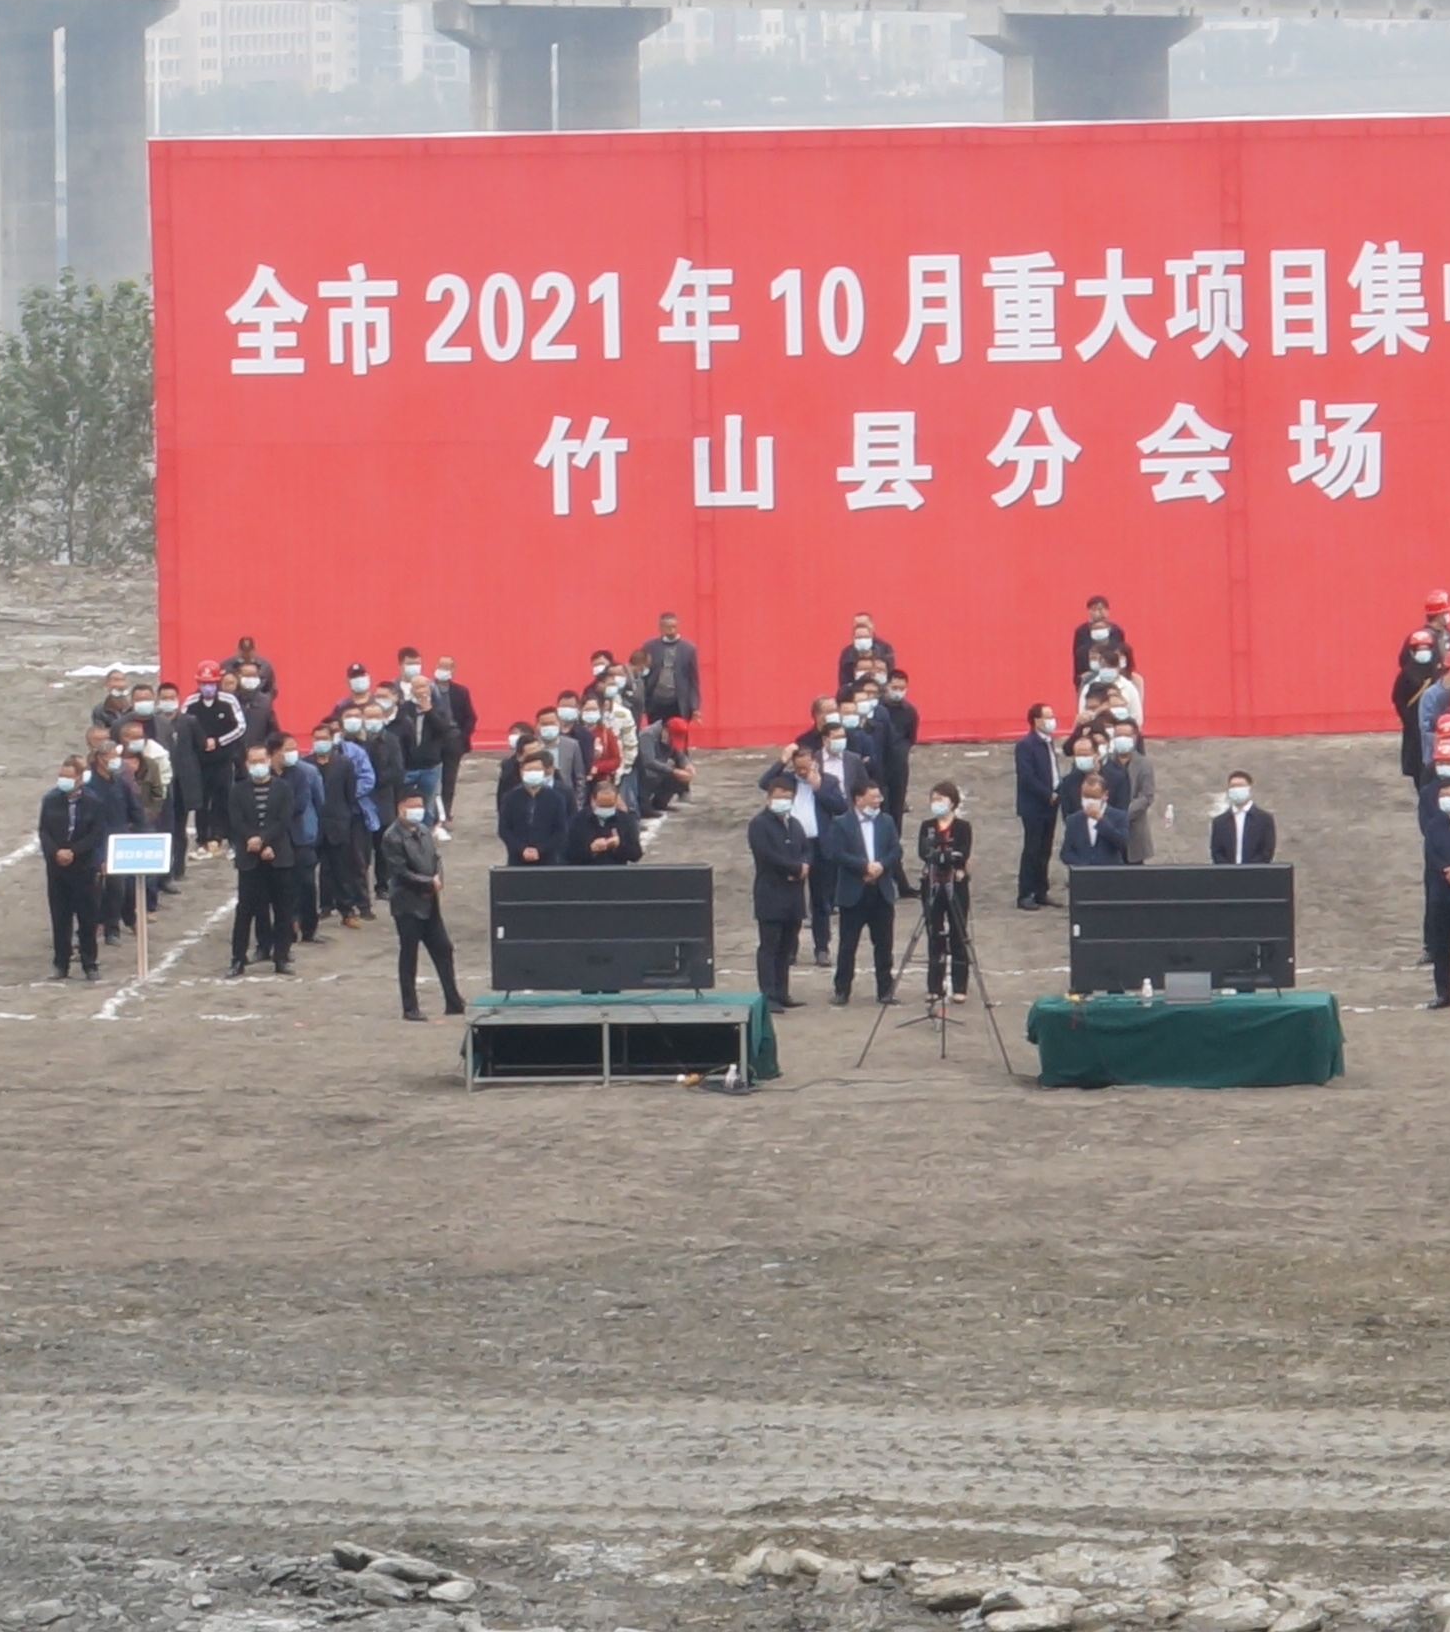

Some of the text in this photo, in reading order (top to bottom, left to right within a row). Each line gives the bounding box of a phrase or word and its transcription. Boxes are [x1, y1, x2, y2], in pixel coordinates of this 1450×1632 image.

[533, 398, 1384, 516] 竹山县分会场
